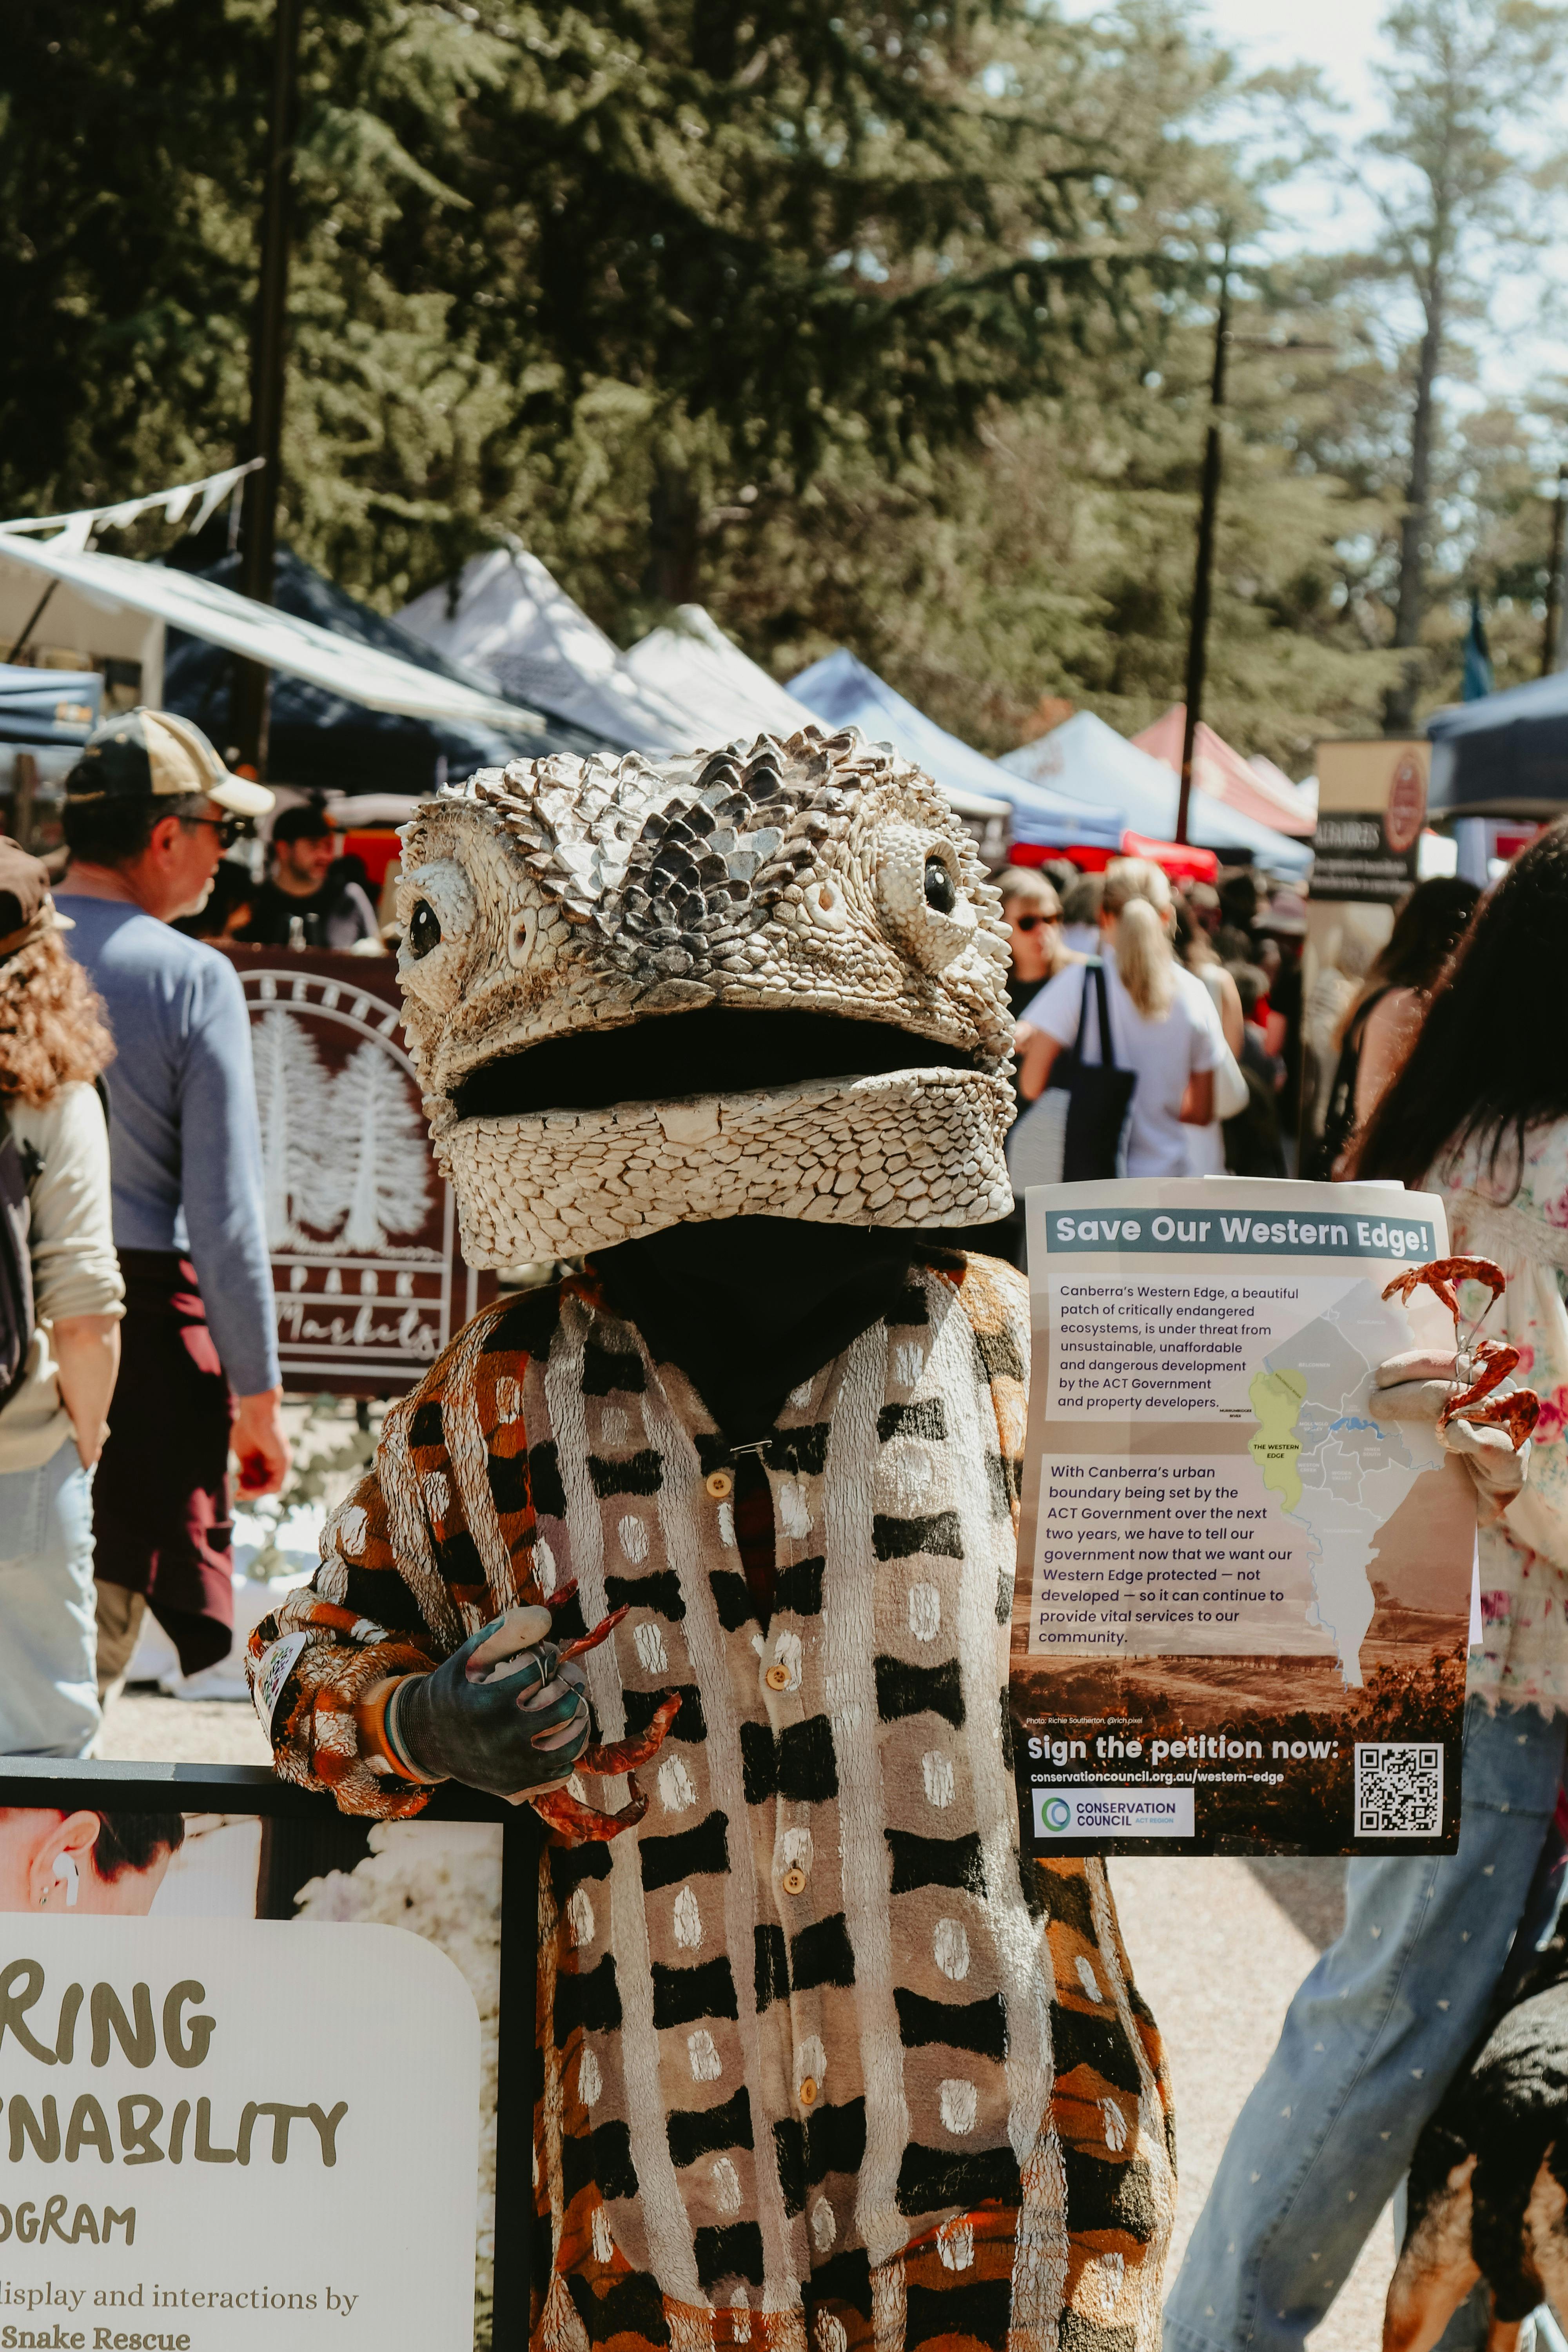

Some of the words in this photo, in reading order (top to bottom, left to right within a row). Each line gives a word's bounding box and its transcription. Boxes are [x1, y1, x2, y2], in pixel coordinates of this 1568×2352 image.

[1057, 1217, 1142, 1241] Save
[1151, 1216, 1211, 1242] Our
[1220, 1217, 1349, 1245] Western
[1357, 1222, 1428, 1257] Edge!
[290, 1266, 414, 1297] PARK
[1061, 1285, 1134, 1296] Canberra’s
[1138, 1287, 1190, 1297] Western
[1194, 1287, 1227, 1301] Edge,
[1243, 1288, 1298, 1299] beautiful
[1062, 1304, 1099, 1318] patch
[1103, 1304, 1115, 1315] of
[1118, 1304, 1173, 1319] critically
[1176, 1305, 1254, 1319] endangered
[1061, 1323, 1141, 1336] ecosystems,
[1145, 1323, 1155, 1334] is
[1159, 1323, 1196, 1334] under
[1200, 1324, 1238, 1334] threat
[1241, 1324, 1271, 1335] from
[1061, 1341, 1156, 1354] unsustainable,
[1160, 1341, 1242, 1353] unaffordable
[1060, 1359, 1085, 1370] and
[1089, 1359, 1158, 1374] dangerous
[1162, 1360, 1246, 1374] development
[1060, 1377, 1075, 1391] by
[1079, 1377, 1099, 1388] the
[1103, 1378, 1129, 1388] ACT
[1132, 1379, 1211, 1389] Government
[1058, 1396, 1083, 1406] and
[1087, 1397, 1142, 1410] property
[1145, 1396, 1219, 1410] developers.
[1051, 1465, 1084, 1477] With
[1089, 1466, 1169, 1478] Canberra’s
[1173, 1466, 1215, 1478] urban
[1049, 1486, 1121, 1502] boundary
[1125, 1486, 1165, 1502] being
[1169, 1488, 1191, 1498] set
[1194, 1487, 1212, 1502] by
[1216, 1487, 1238, 1498] the
[1047, 1508, 1078, 1519] ACT
[1082, 1508, 1172, 1519] Government
[1175, 1510, 1207, 1519] over
[1210, 1507, 1233, 1519] the
[1237, 1508, 1267, 1519] next
[1046, 1528, 1073, 1539] two
[1078, 1531, 1120, 1543] years,
[1125, 1530, 1145, 1539] we
[1149, 1528, 1184, 1539] have
[1188, 1528, 1201, 1539] to
[1205, 1528, 1227, 1539] tell
[1231, 1530, 1254, 1539] our
[1045, 1549, 1135, 1563] government
[1139, 1551, 1169, 1560] now
[1172, 1548, 1201, 1560] that
[1205, 1551, 1225, 1559] we
[1229, 1549, 1265, 1560] want
[1269, 1551, 1292, 1560] our
[1044, 1569, 1104, 1581] Western
[1108, 1569, 1143, 1584] Edge
[1147, 1569, 1217, 1584] protected
[1238, 1570, 1261, 1580] not
[1042, 1589, 1119, 1606] developed
[1139, 1592, 1156, 1601] so
[1160, 1589, 1169, 1601] it
[1172, 1592, 1199, 1601] can
[1203, 1589, 1266, 1601] continue
[1270, 1590, 1284, 1601] to
[1040, 1610, 1096, 1625] provide
[1101, 1610, 1131, 1622] vital
[1135, 1609, 1194, 1623] services
[1198, 1610, 1212, 1622] to
[1216, 1612, 1240, 1622] our
[1039, 1630, 1127, 1646] community.
[1028, 1735, 1087, 1766] Sign
[1096, 1735, 1142, 1758] the
[1152, 1734, 1262, 1766] petition
[1272, 1740, 1339, 1759] now:
[1031, 1769, 1284, 1785] conservationcouncil.org.au/western-edge
[1076, 1803, 1176, 1813] CONSERVATION
[1077, 1815, 1132, 1826] COUNCIL
[0, 2094, 348, 2167] NABILITY
[0, 2280, 86, 2312] isplay
[93, 2283, 145, 2307] and
[152, 2284, 317, 2309] interactions
[325, 2287, 359, 2316] by
[2, 2324, 85, 2349] Snake
[93, 2327, 191, 2351] Rescue
